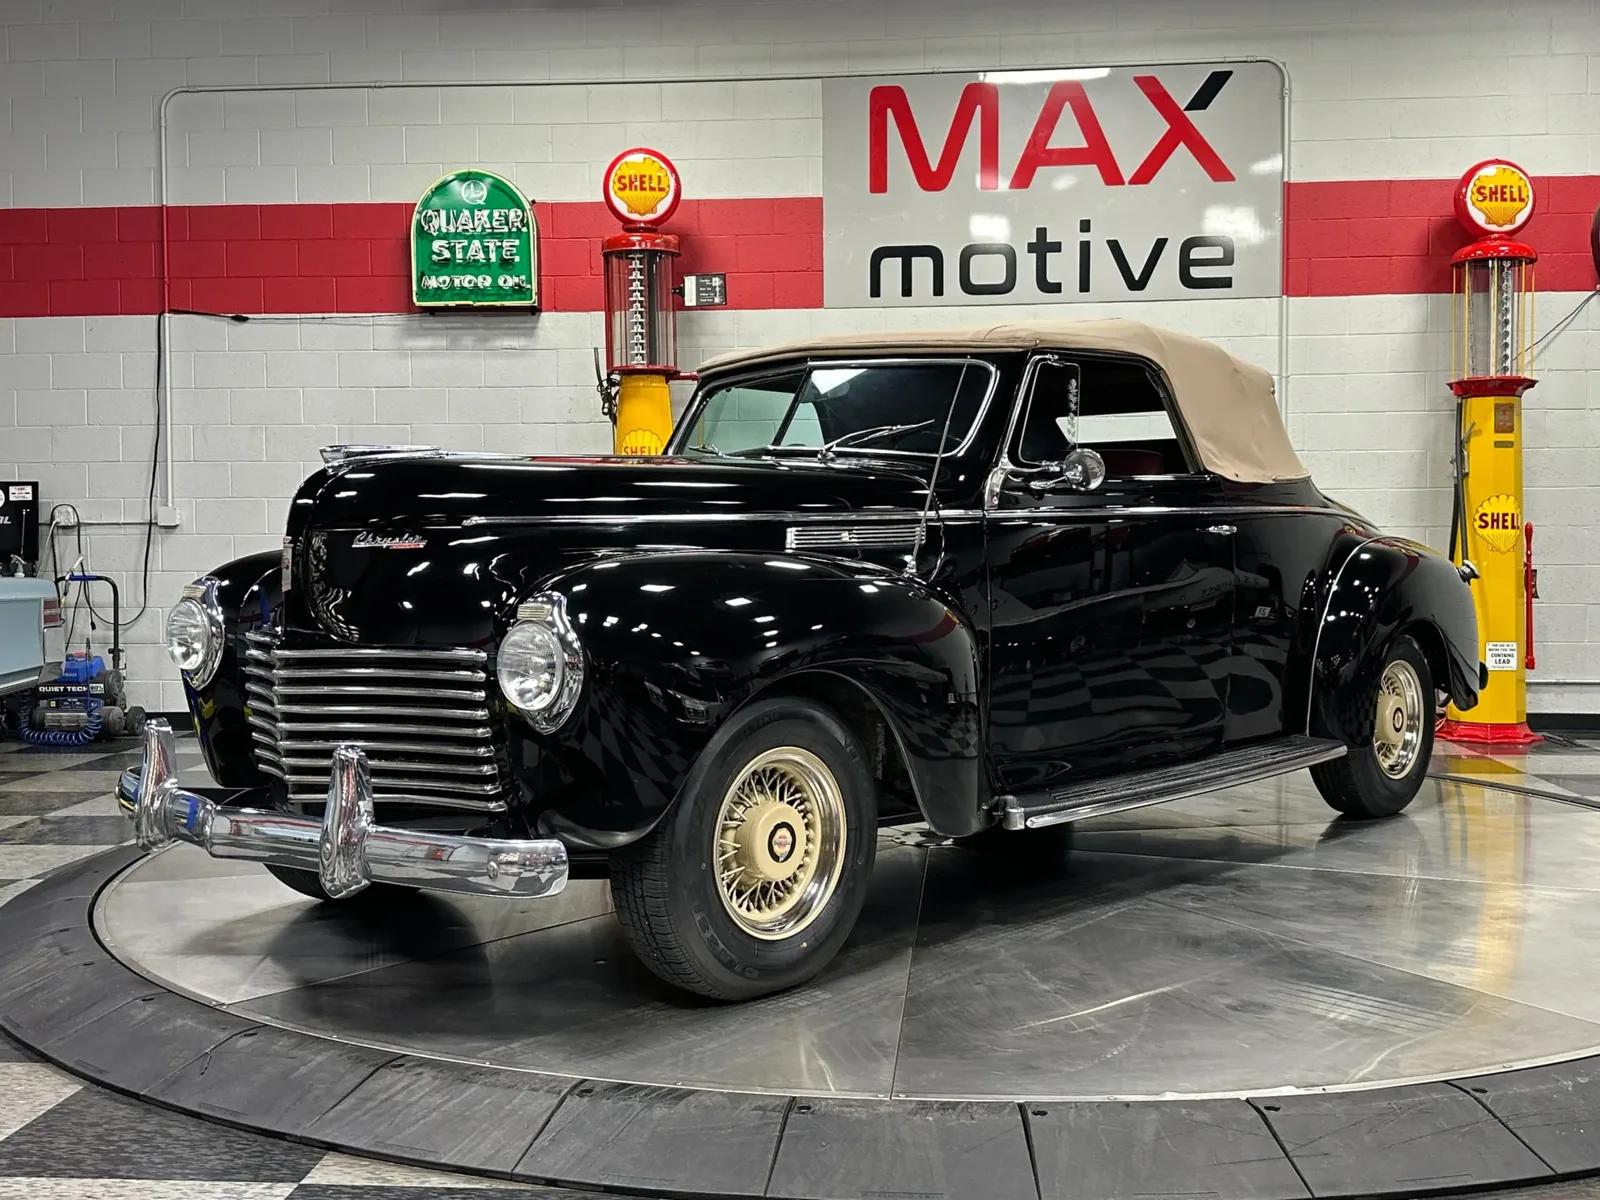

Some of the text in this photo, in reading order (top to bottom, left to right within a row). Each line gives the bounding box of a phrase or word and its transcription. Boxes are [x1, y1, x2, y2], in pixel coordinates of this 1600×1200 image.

[869, 70, 1236, 194] MAX
[617, 174, 666, 192] SHELL
[1475, 185, 1526, 203] SHELL
[421, 209, 528, 235] QUAKER
[432, 239, 520, 263] STATE
[870, 218, 1235, 298] motive
[421, 275, 531, 289] MOTOR OIL
[1478, 512, 1520, 530] SHELL
[352, 531, 428, 549] Chrysler
